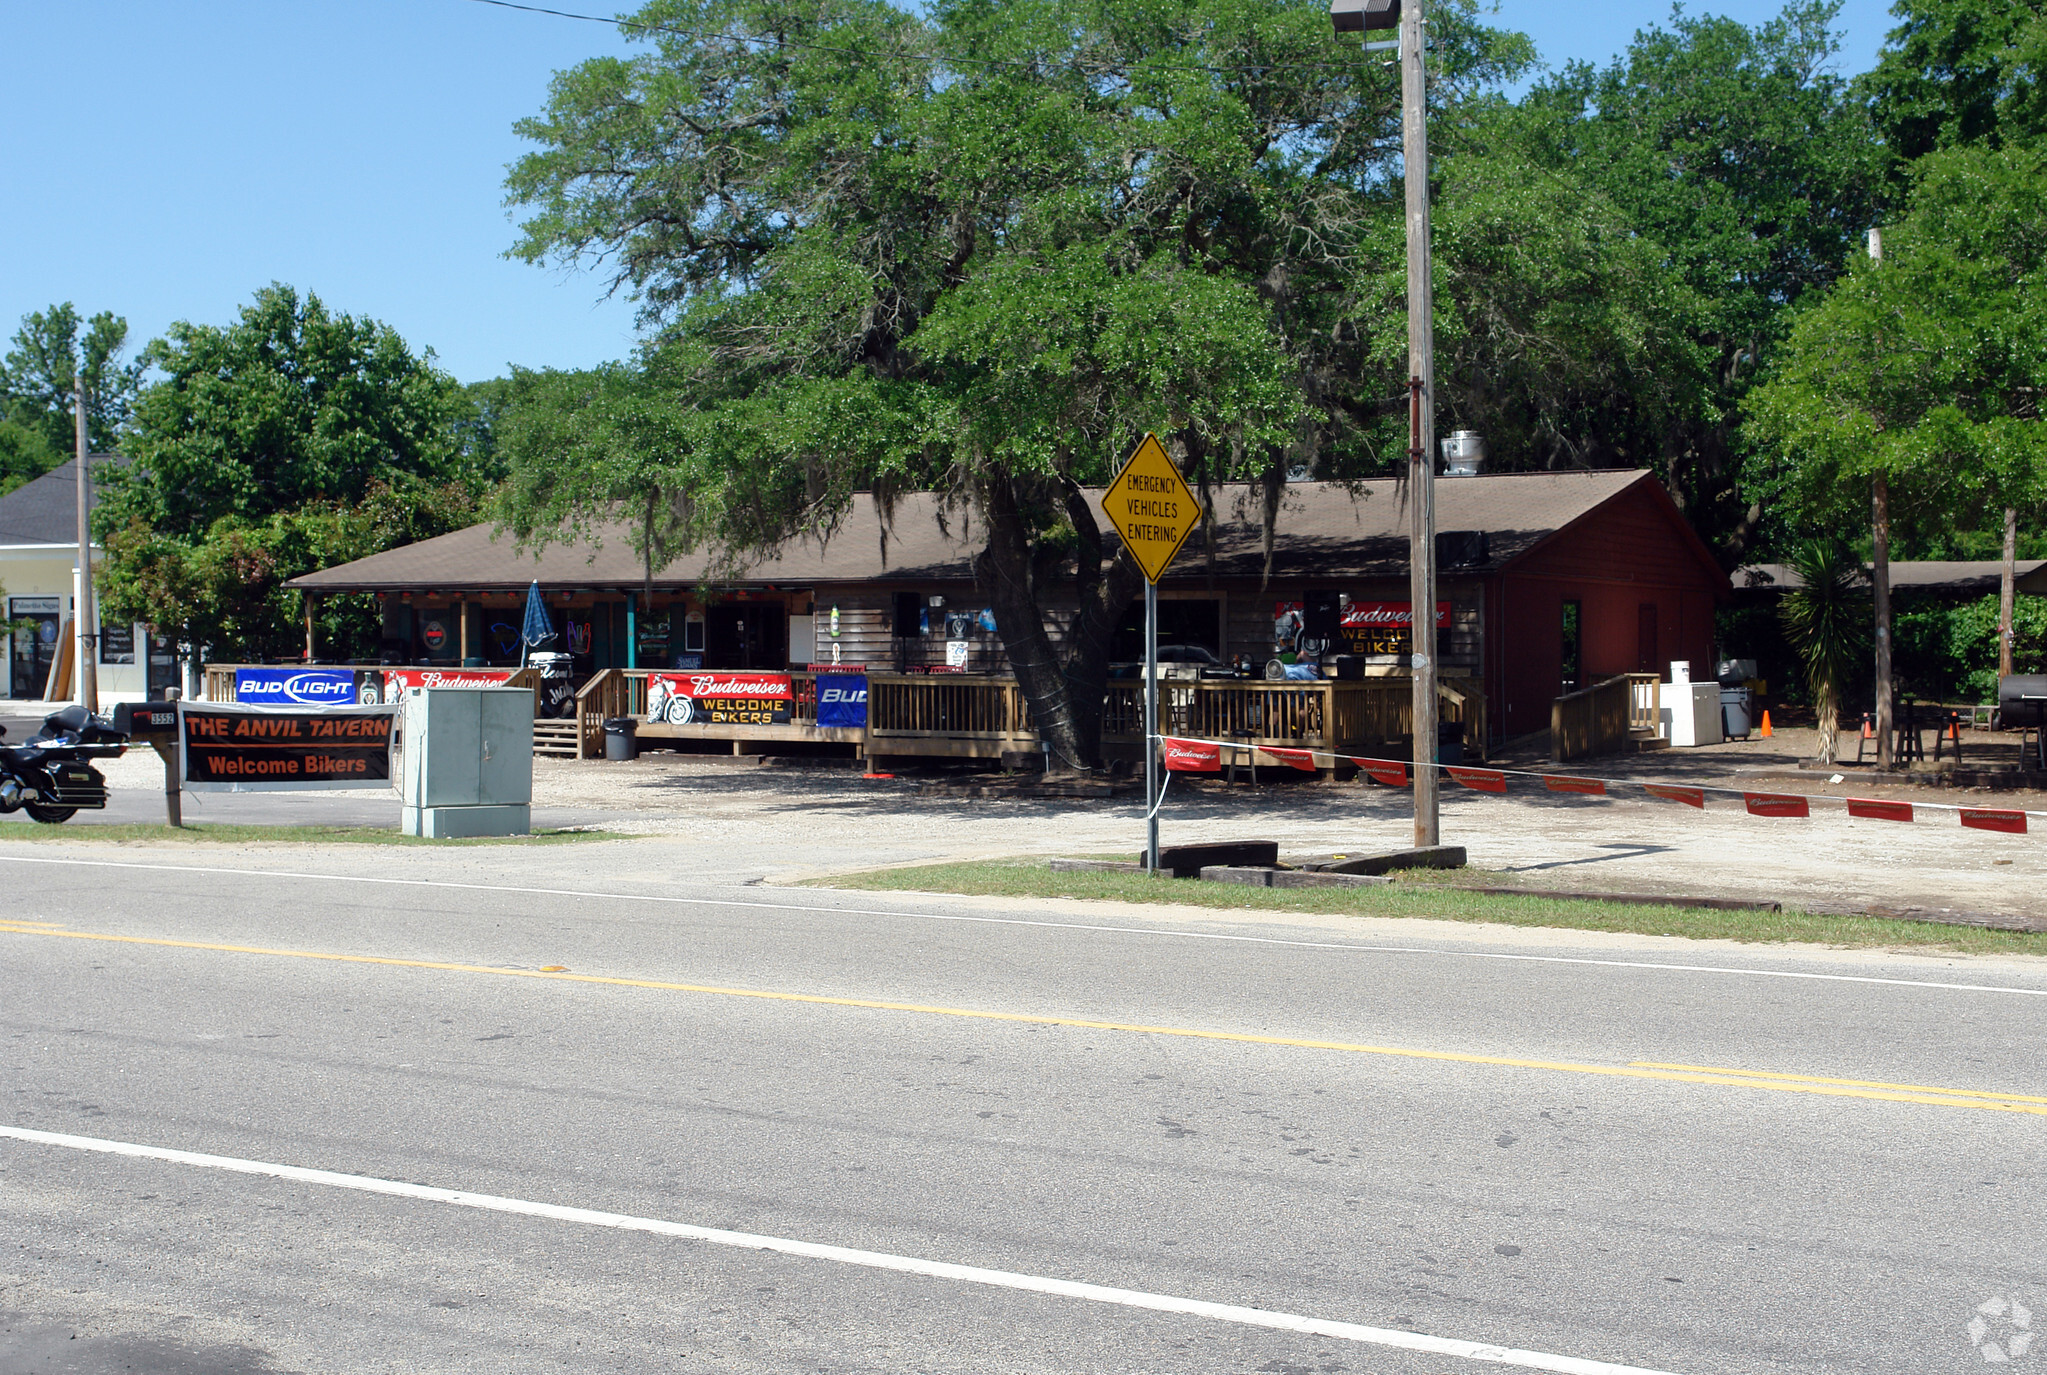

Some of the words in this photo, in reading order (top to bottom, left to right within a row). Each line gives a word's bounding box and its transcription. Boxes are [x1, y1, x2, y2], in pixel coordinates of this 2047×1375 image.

[1127, 474, 1176, 494] EMERGENCY
[1127, 498, 1178, 519] VEHICLES
[1128, 523, 1177, 543] ENTERING
[1352, 642, 1411, 654] BIKER
[239, 680, 283, 693] BUD
[292, 681, 352, 694] LIGHT
[690, 676, 787, 696] Budweiser
[703, 699, 784, 712] WELCOME
[151, 713, 173, 724] 3552
[712, 711, 772, 723] BIKERS
[186, 718, 229, 736] THE
[234, 719, 302, 737] ANVIL
[309, 719, 390, 736] TAVERN
[1168, 747, 1217, 760] Budweiser
[208, 756, 299, 774] Welcome
[305, 755, 367, 773] Bikers
